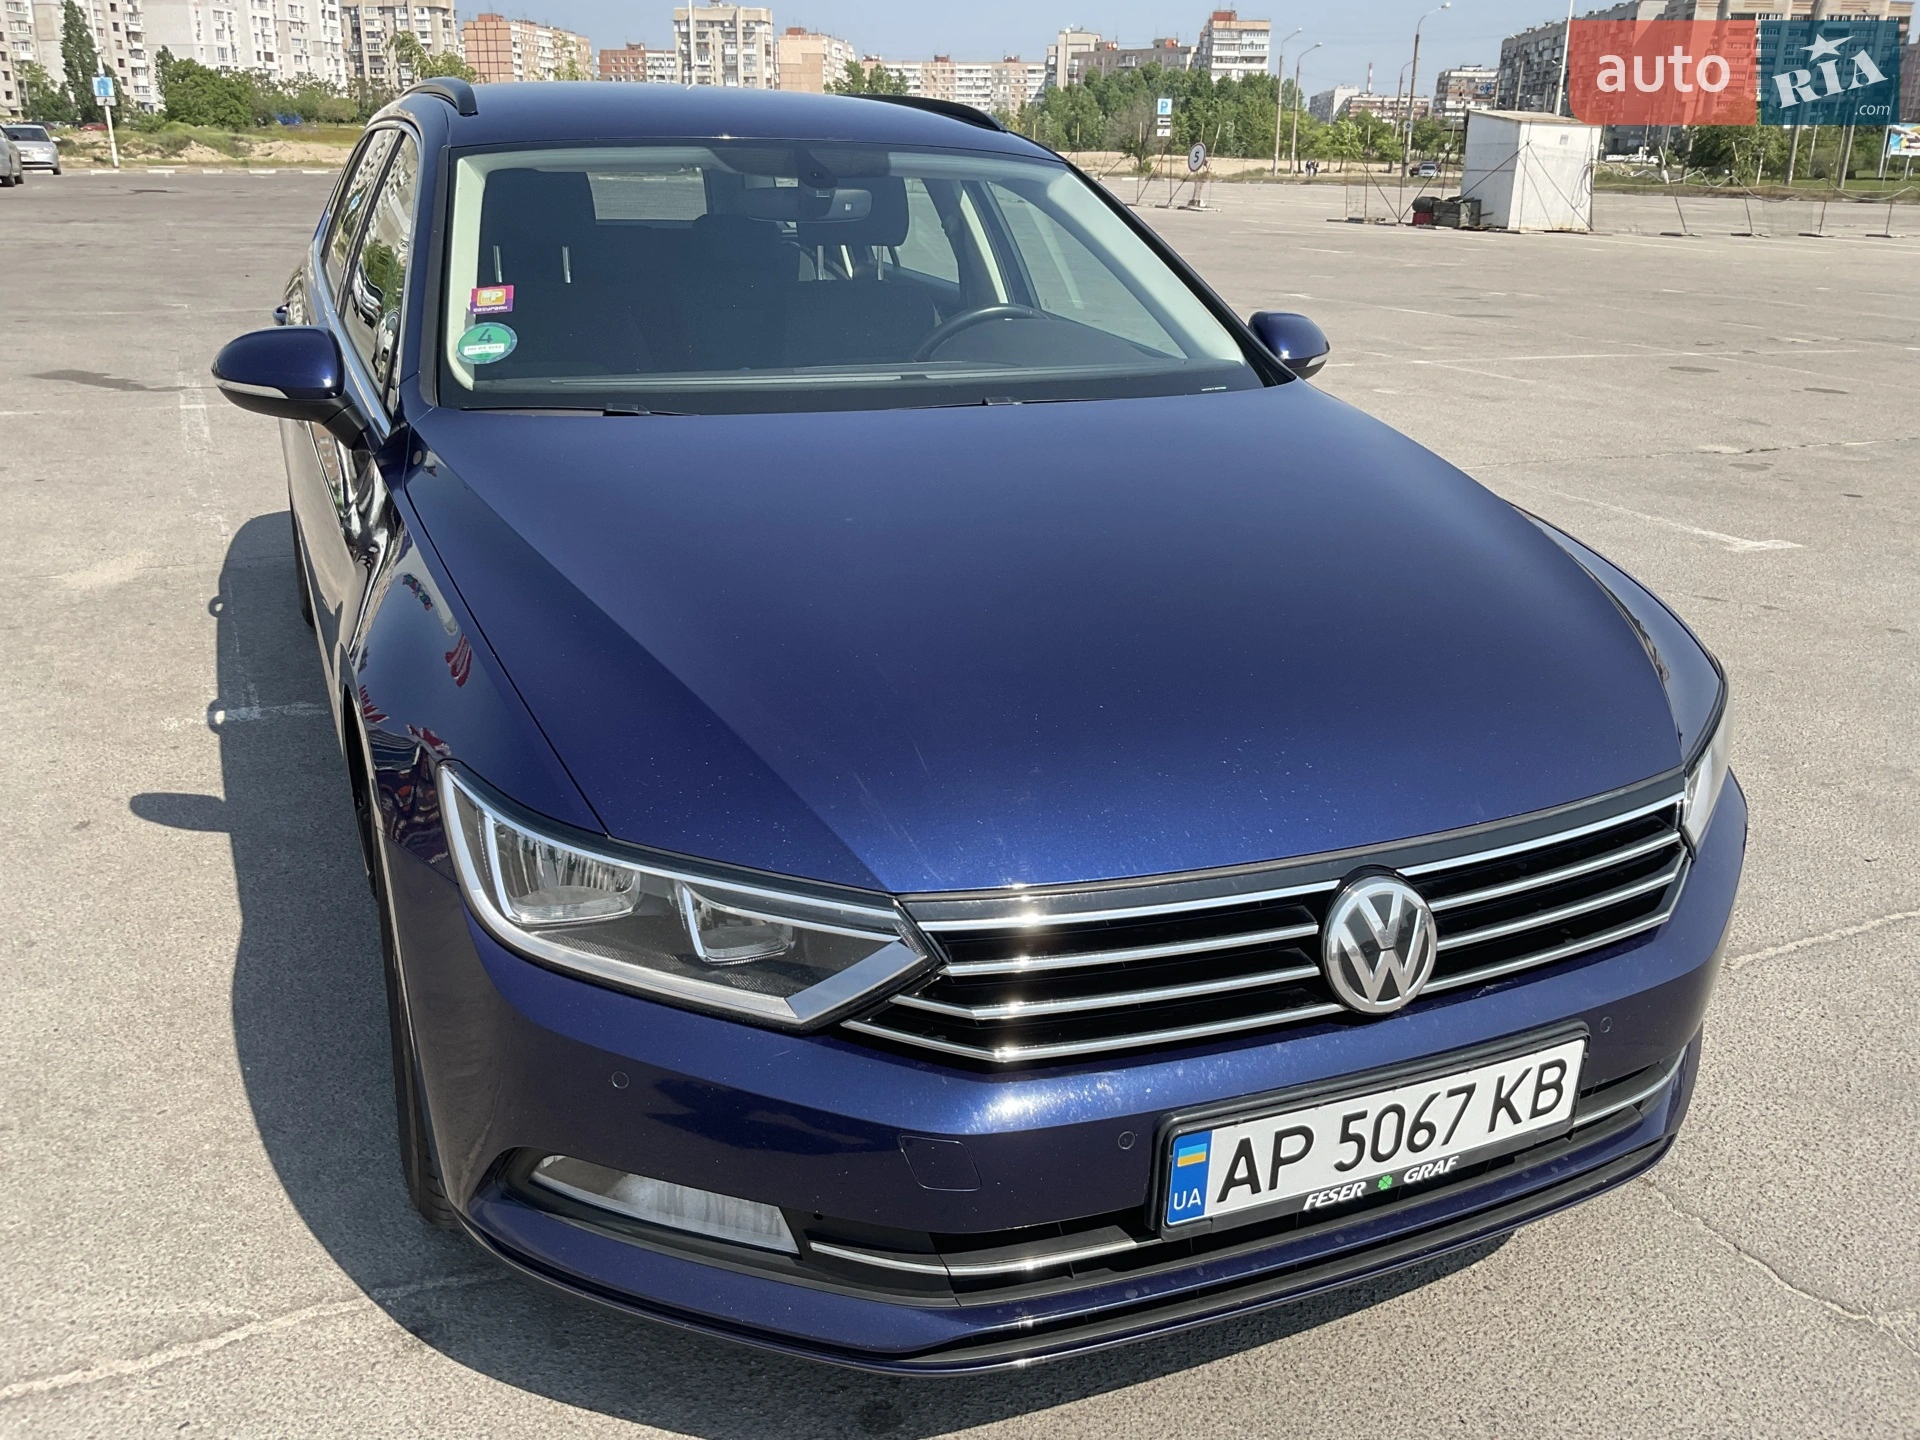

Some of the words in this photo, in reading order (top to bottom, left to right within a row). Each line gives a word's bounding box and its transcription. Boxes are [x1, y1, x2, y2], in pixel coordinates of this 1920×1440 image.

[1160, 101, 1169, 114] P
[1193, 151, 1200, 163] 5
[478, 328, 493, 343] 4
[1217, 1124, 1314, 1203] AP
[1334, 1083, 1477, 1173] 5067
[1488, 1058, 1567, 1133] KB
[1303, 1181, 1368, 1211] FESER
[1403, 1156, 1459, 1184] GRAF
[1173, 1188, 1201, 1210] UA
